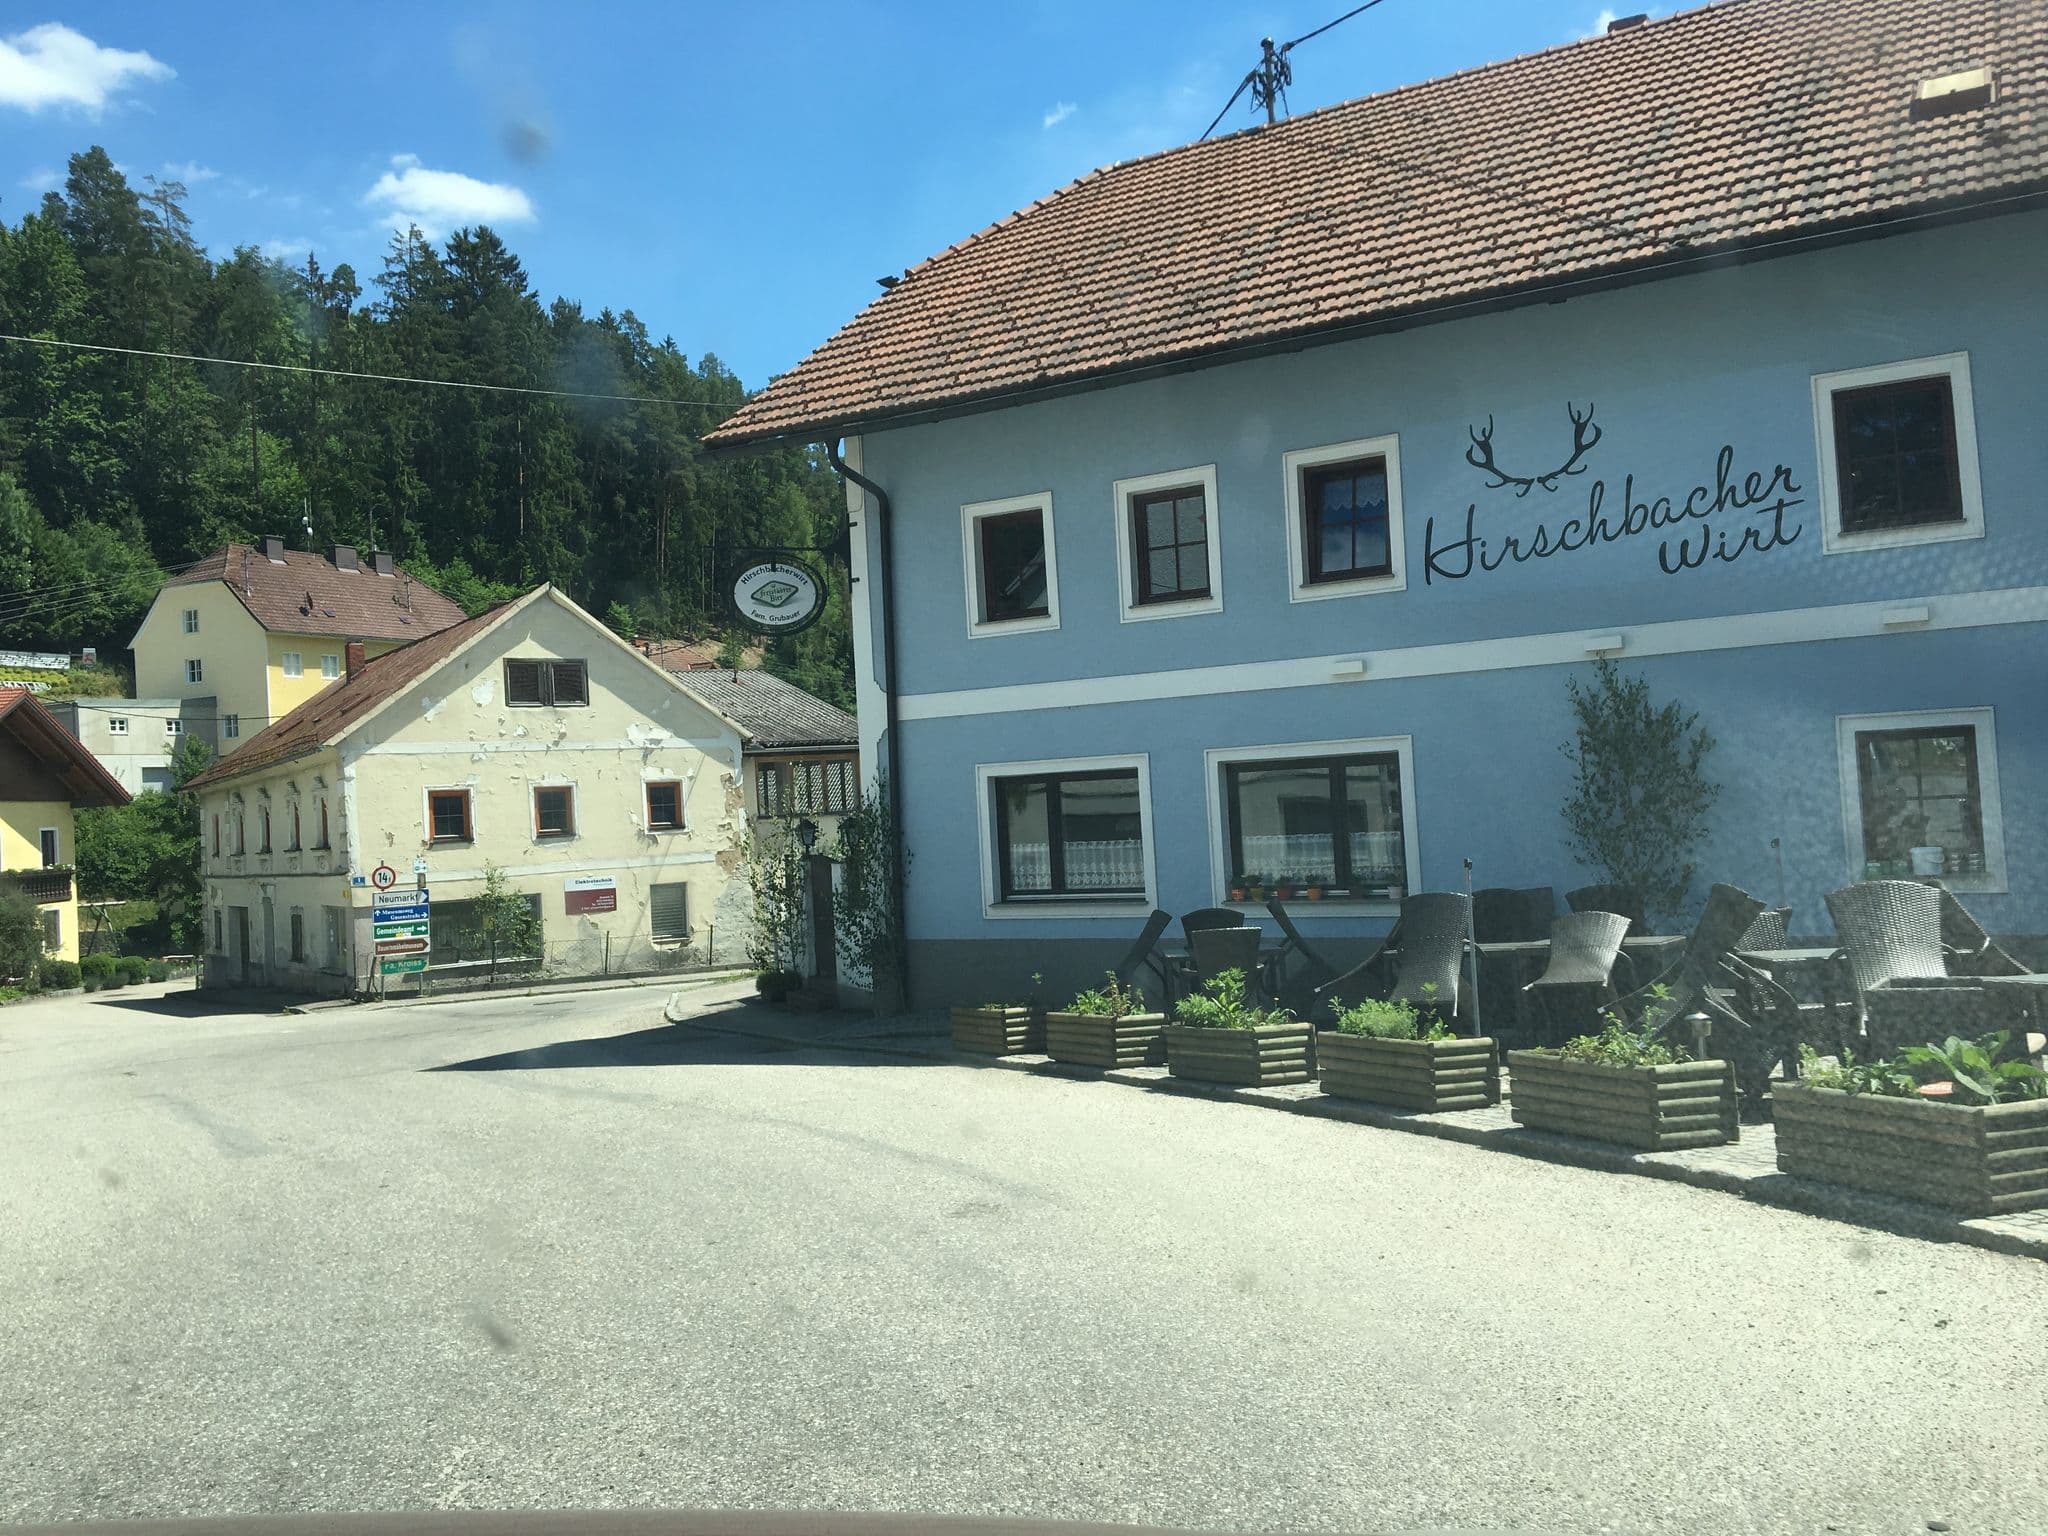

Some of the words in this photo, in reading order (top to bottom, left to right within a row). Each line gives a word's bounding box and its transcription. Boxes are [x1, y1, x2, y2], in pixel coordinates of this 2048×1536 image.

[1423, 444, 1802, 585] Hirschbacher
[1658, 497, 1804, 574] Wirt
[740, 565, 808, 585] Hirschbcherwirt
[378, 894, 418, 904] Neumarkt
